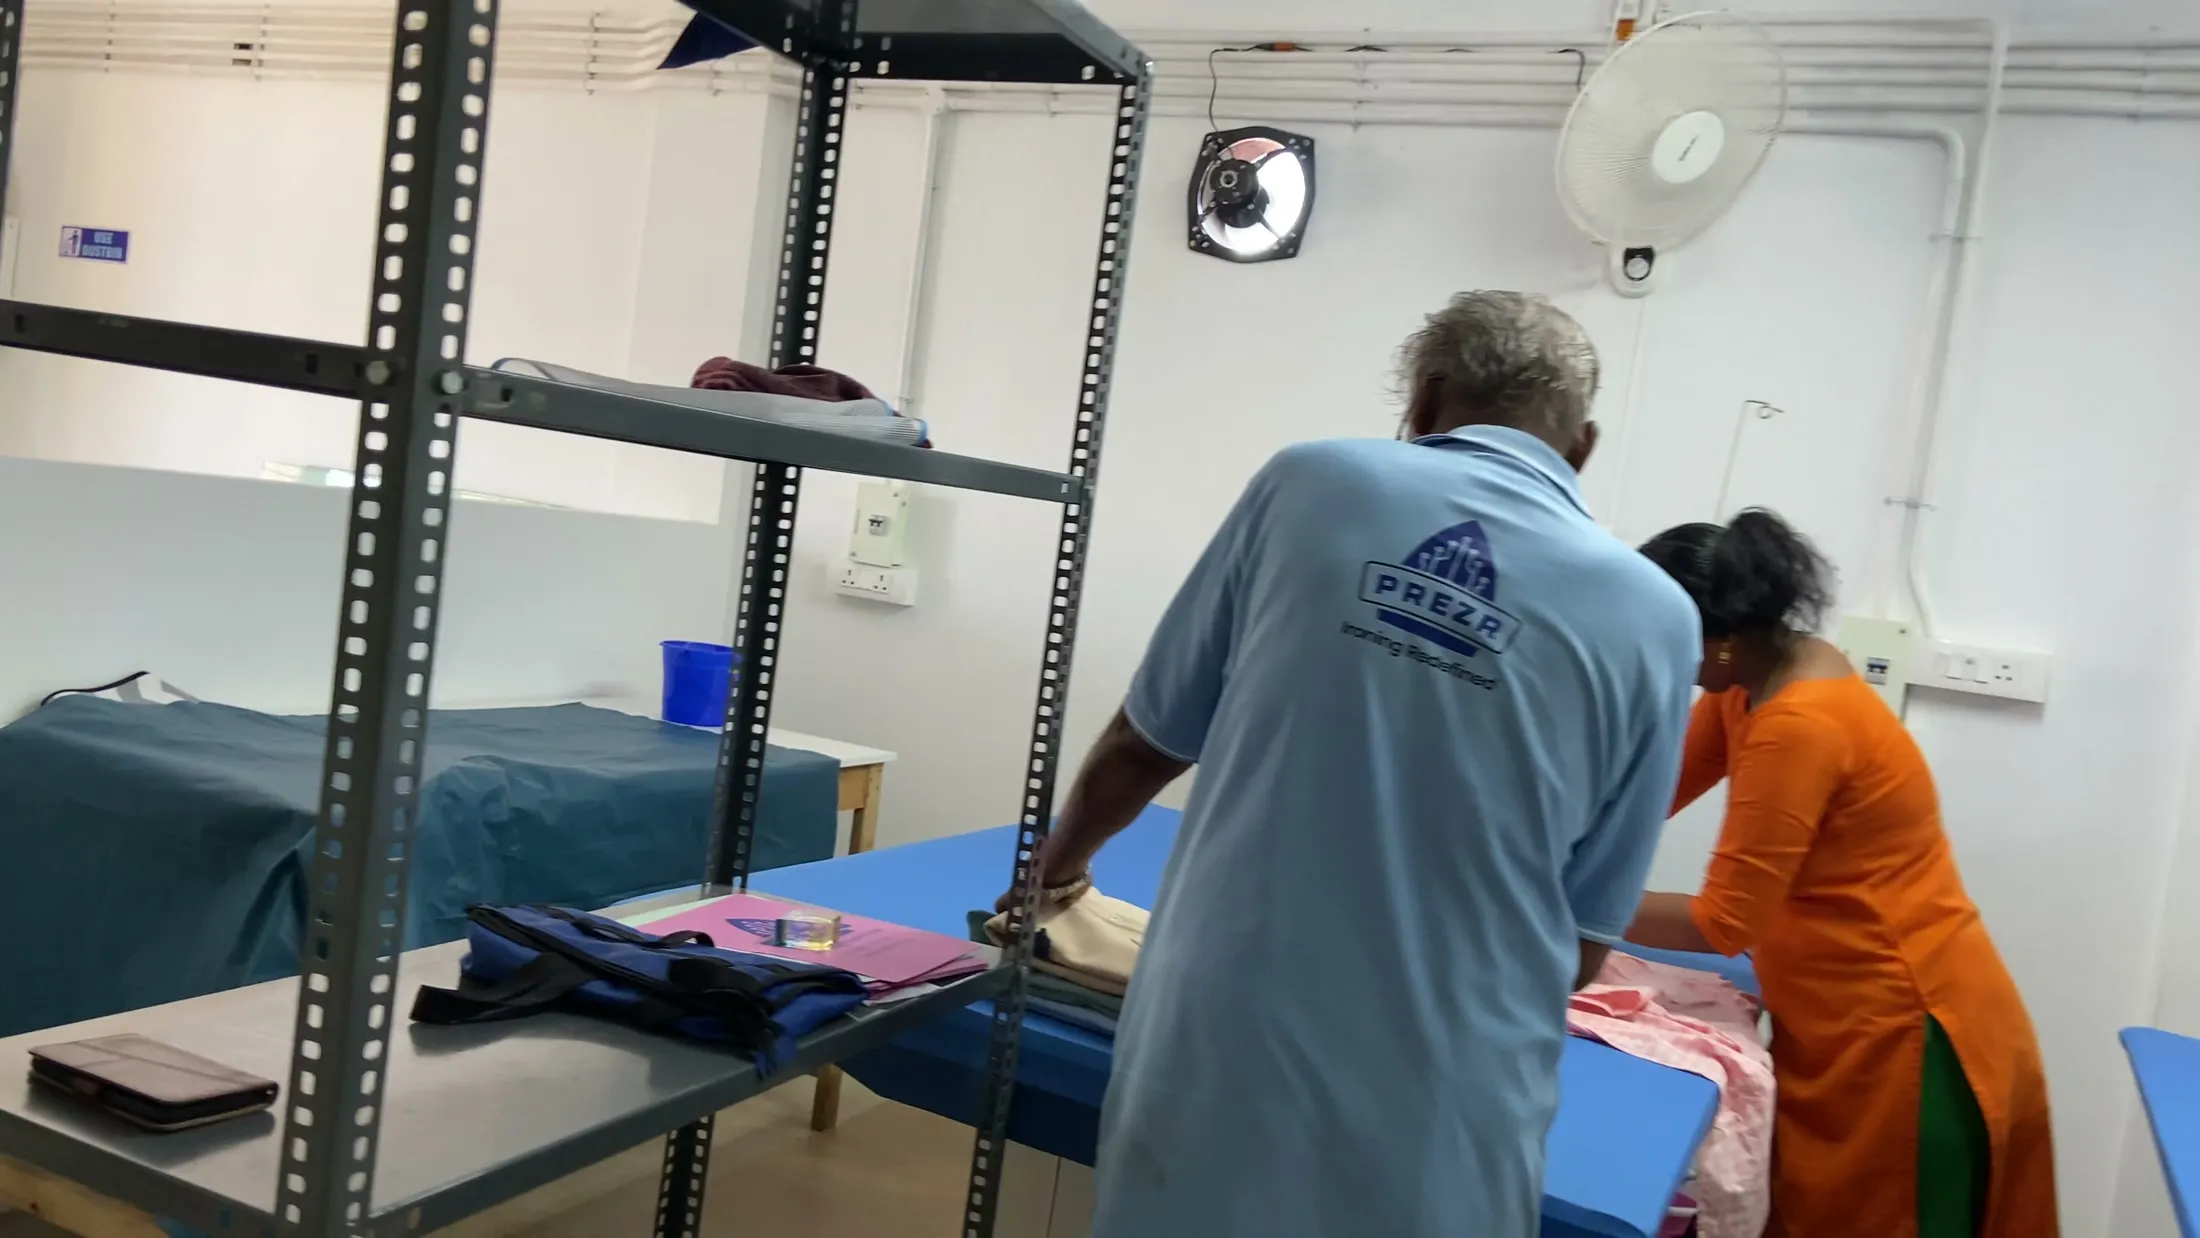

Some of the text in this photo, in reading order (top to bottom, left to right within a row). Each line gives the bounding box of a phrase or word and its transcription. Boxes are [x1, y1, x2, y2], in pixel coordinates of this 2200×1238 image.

[93, 231, 113, 244] USE
[1375, 573, 1504, 641] PREZR
[1340, 620, 1498, 691] Ironing Redefined
